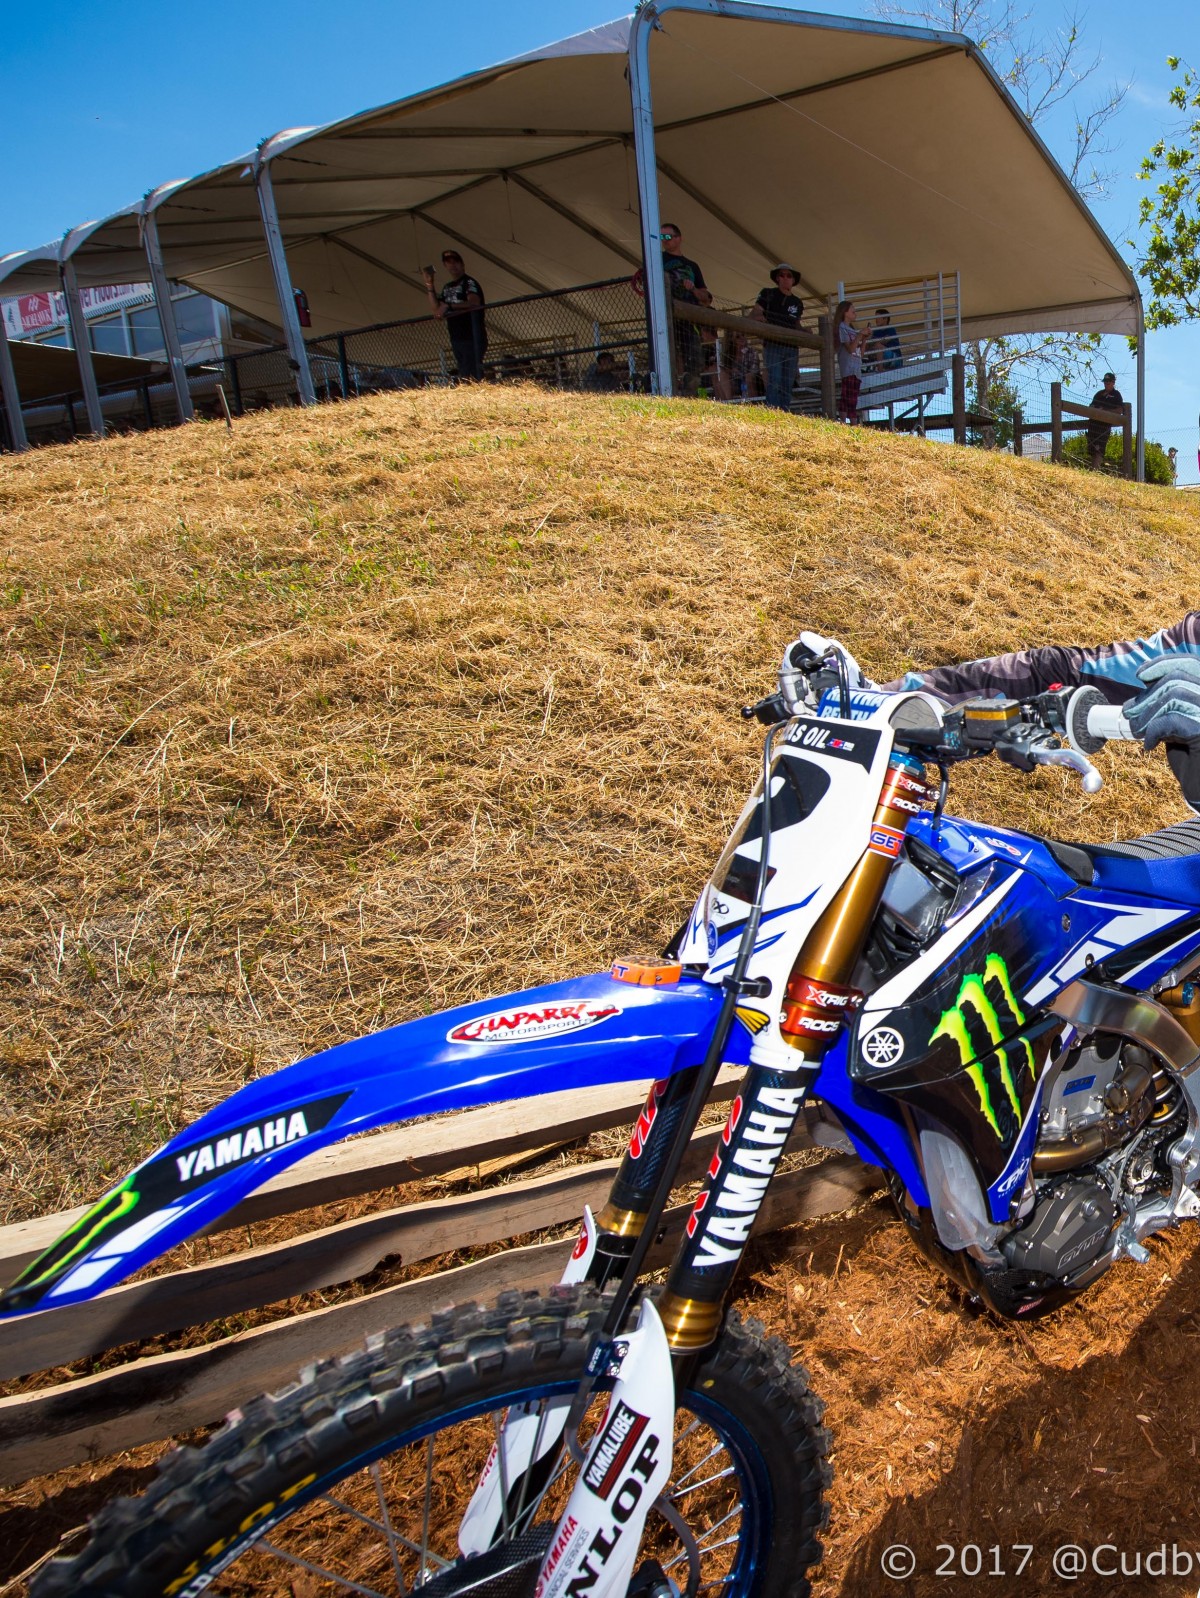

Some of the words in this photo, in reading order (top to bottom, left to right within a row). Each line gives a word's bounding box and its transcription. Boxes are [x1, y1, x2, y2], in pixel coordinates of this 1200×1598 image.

[802, 726, 831, 749] OIL
[484, 1017, 594, 1042] MOTORSPORTS
[176, 1111, 309, 1182] YAMAHA
[692, 1086, 806, 1267] YAMAHA
[585, 1405, 636, 1489] YAMALUBE
[541, 1514, 580, 1582] YAMAHA
[564, 1528, 590, 1569] SERVICES
